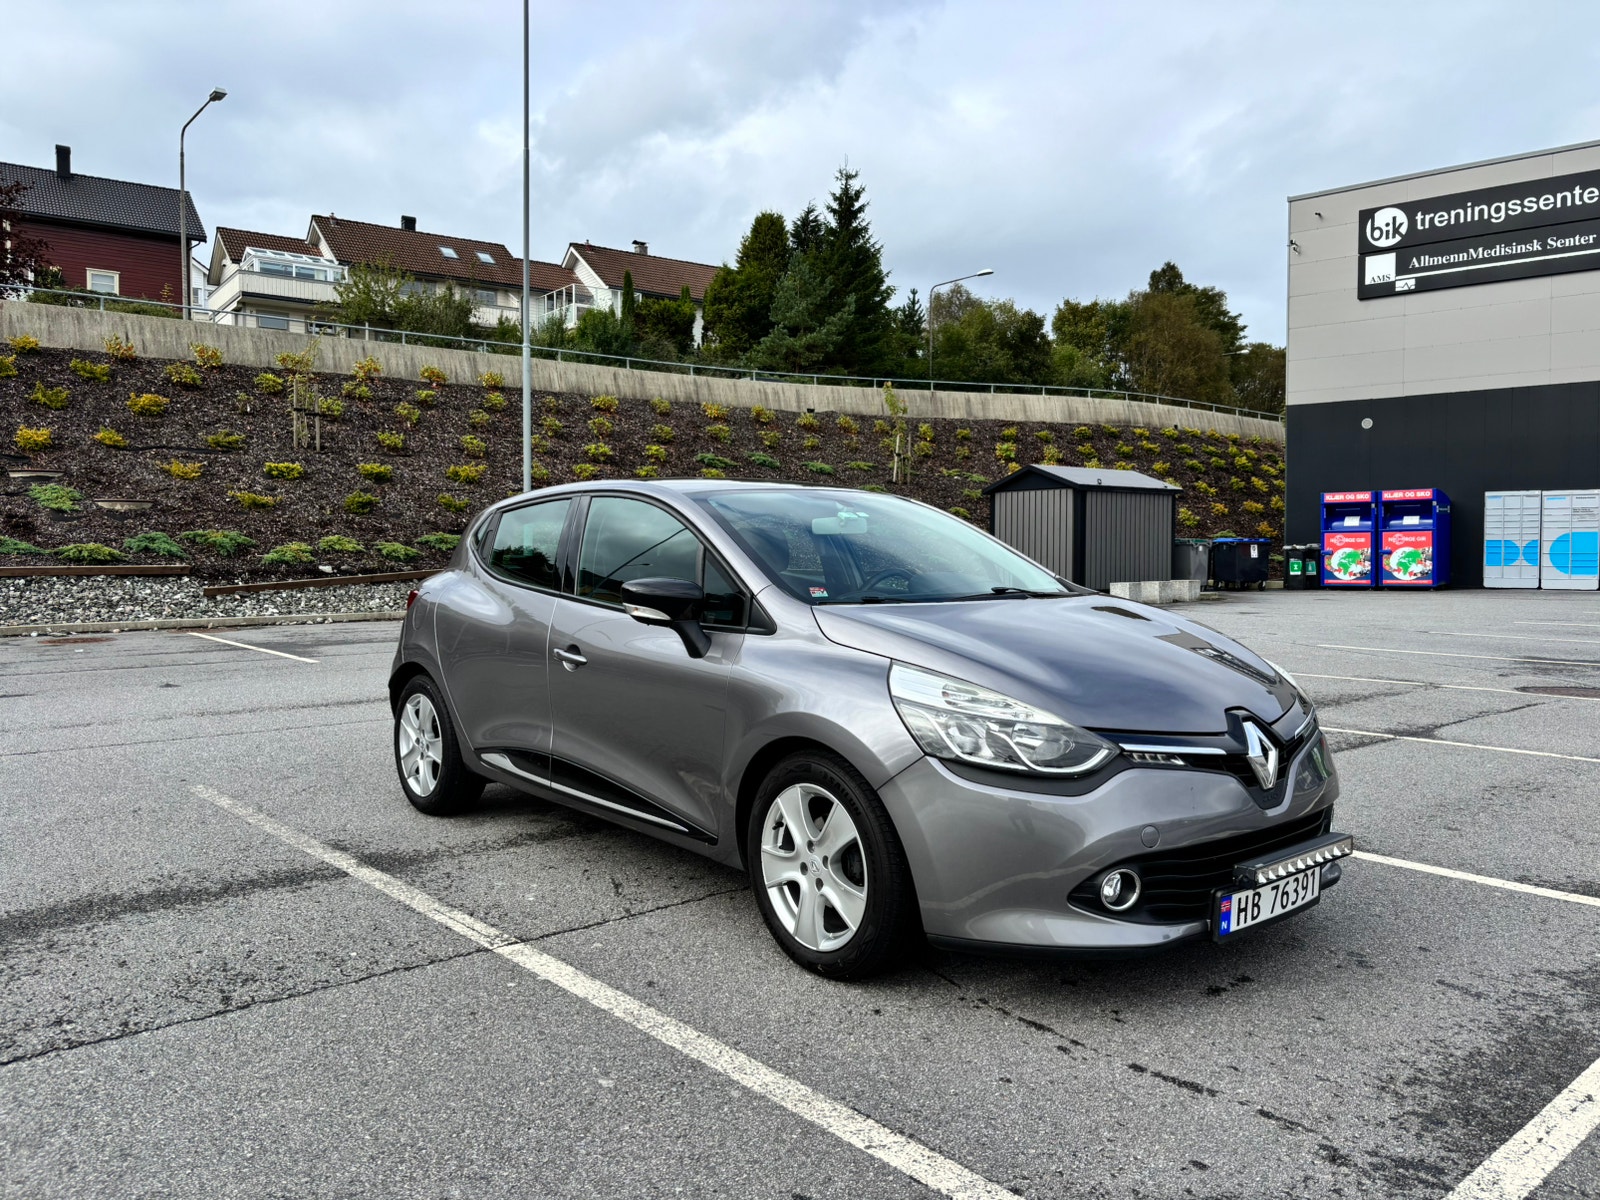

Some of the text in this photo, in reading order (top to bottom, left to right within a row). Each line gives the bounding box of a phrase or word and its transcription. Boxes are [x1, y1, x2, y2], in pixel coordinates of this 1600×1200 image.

[1415, 185, 1600, 230] treningssente
[1368, 212, 1405, 241] bik
[1408, 233, 1597, 269] AllmennMedisinsk Senter
[1369, 273, 1391, 284] AMS
[1236, 869, 1316, 927] HB 76391
[1221, 920, 1228, 930] N
